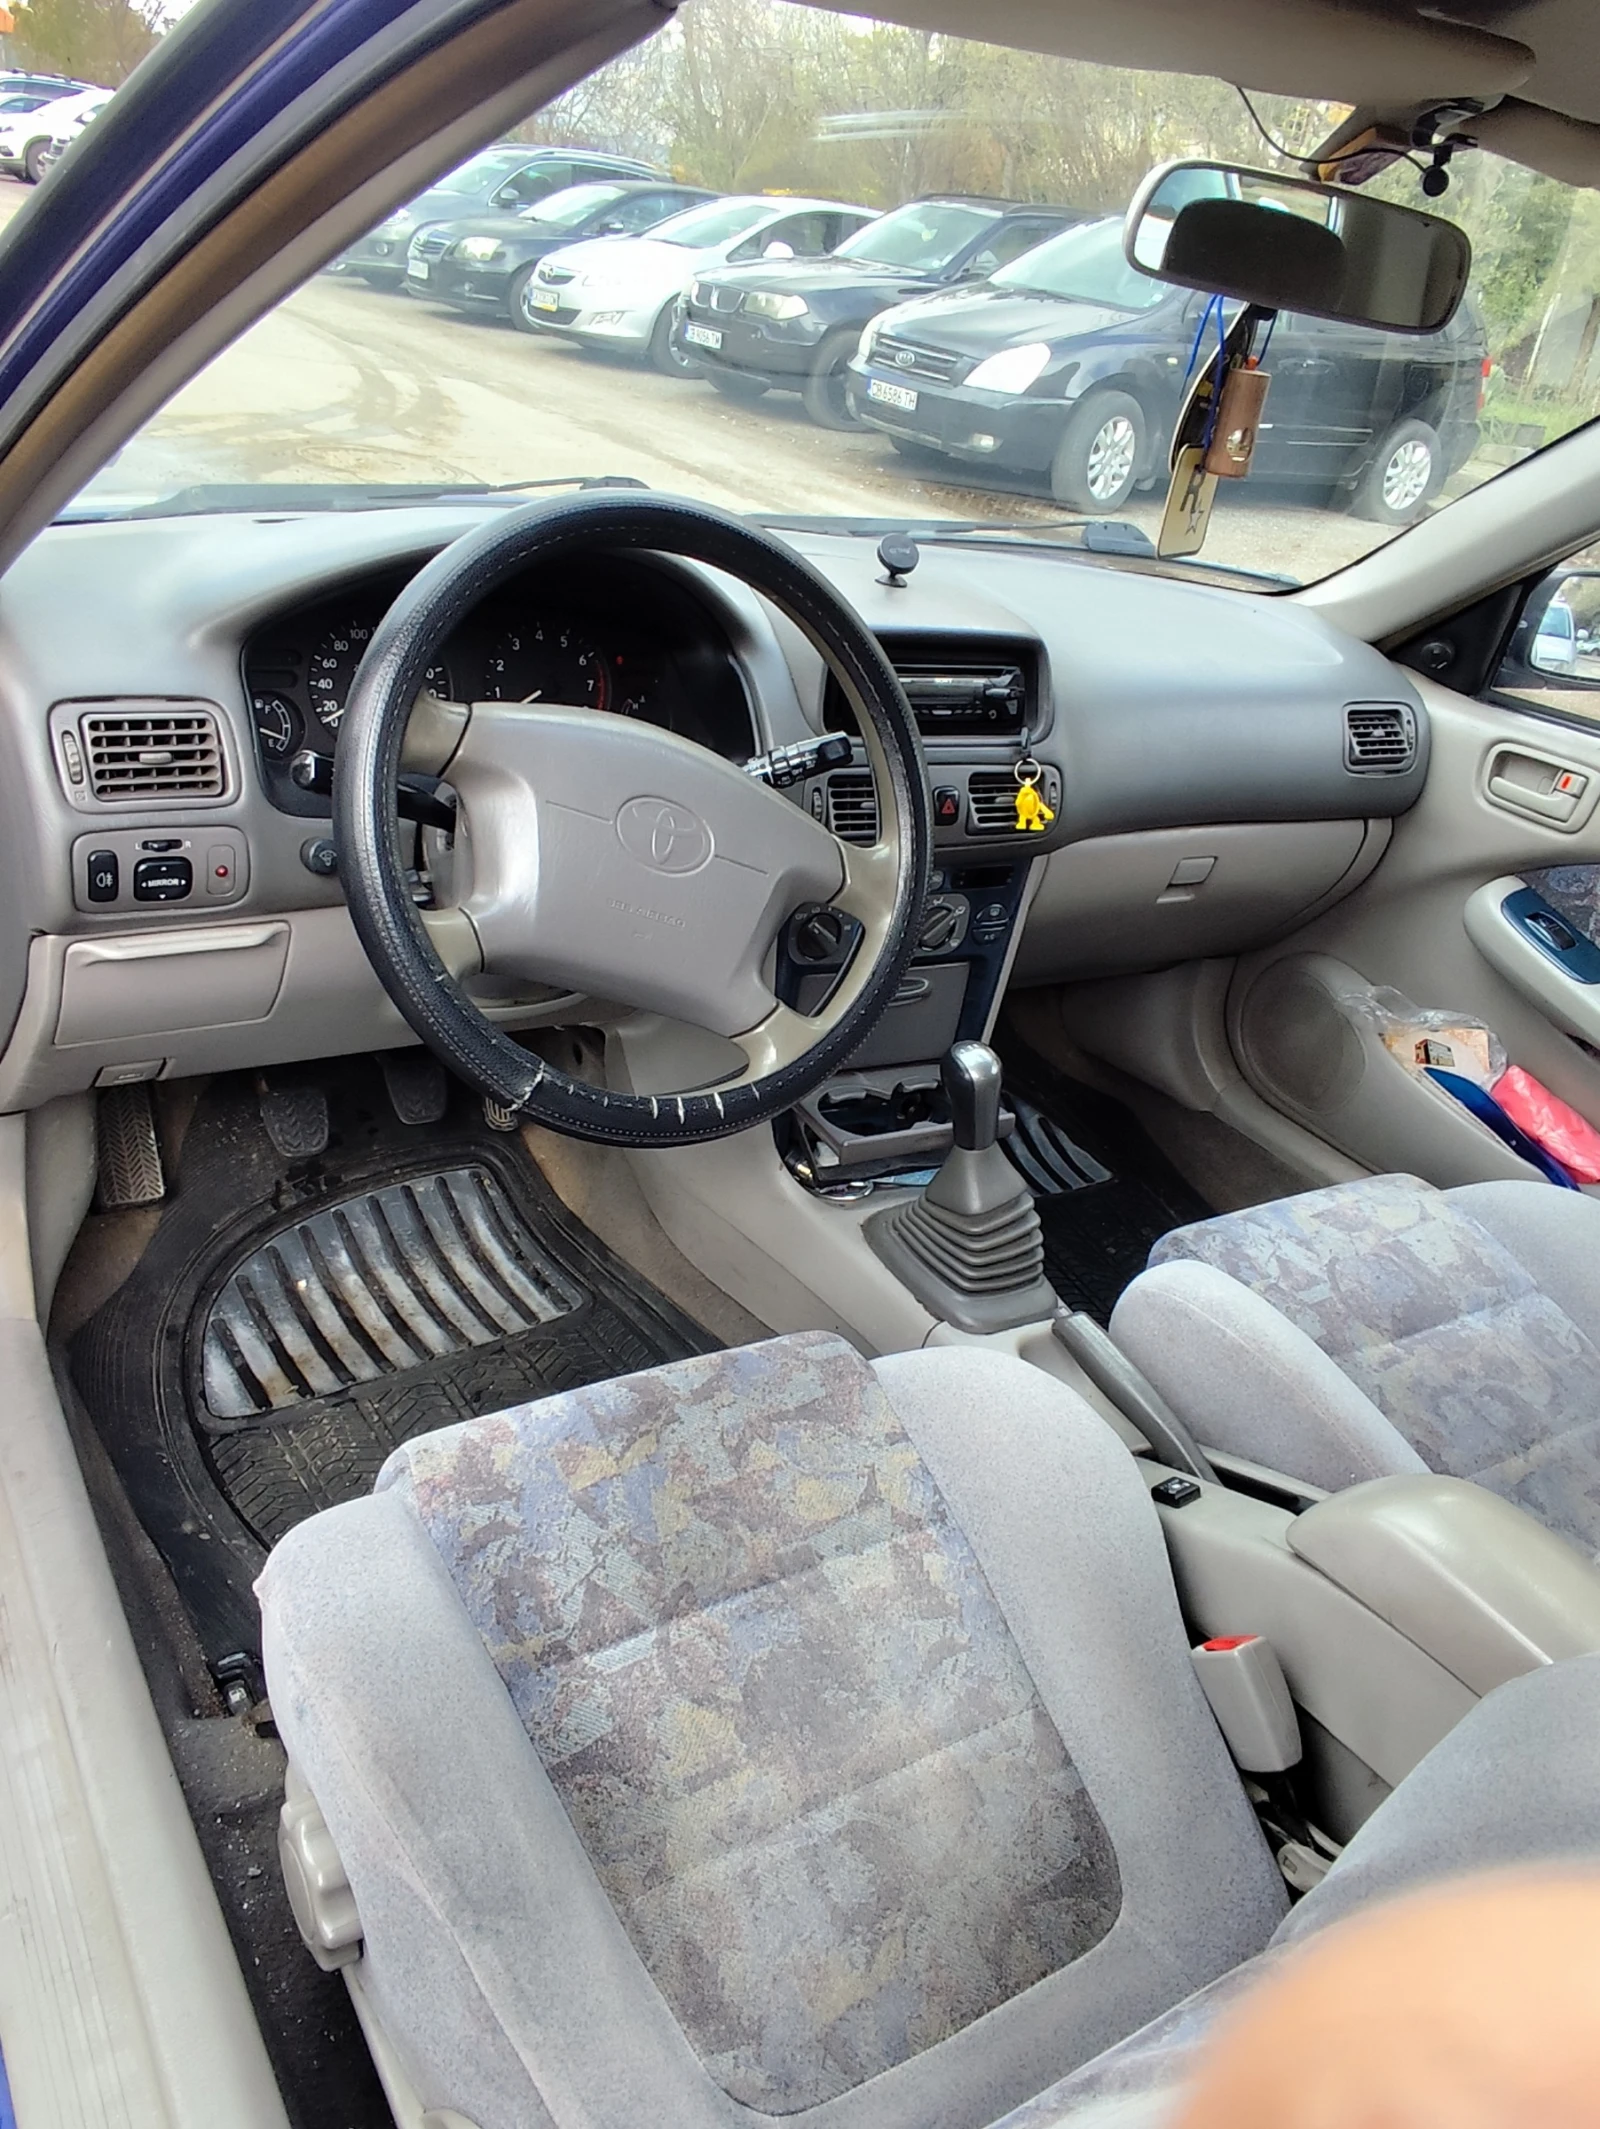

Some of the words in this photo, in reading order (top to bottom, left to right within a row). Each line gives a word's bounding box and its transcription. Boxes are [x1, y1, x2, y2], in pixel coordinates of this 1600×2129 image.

[350, 628, 368, 640] 100
[535, 630, 544, 641] 4
[333, 640, 349, 652] 80
[512, 638, 520, 650] 3
[560, 636, 568, 648] 5
[322, 658, 337, 669] 60
[496, 660, 504, 671] 2
[578, 655, 587, 667] 6
[317, 678, 333, 690] 40
[586, 679, 595, 692] 7
[494, 686, 501, 699] 1
[264, 705, 271, 715] F
[323, 700, 338, 712] 20
[268, 739, 275, 748] E
[184, 840, 192, 848] R
[147, 878, 179, 888] MIRROR
